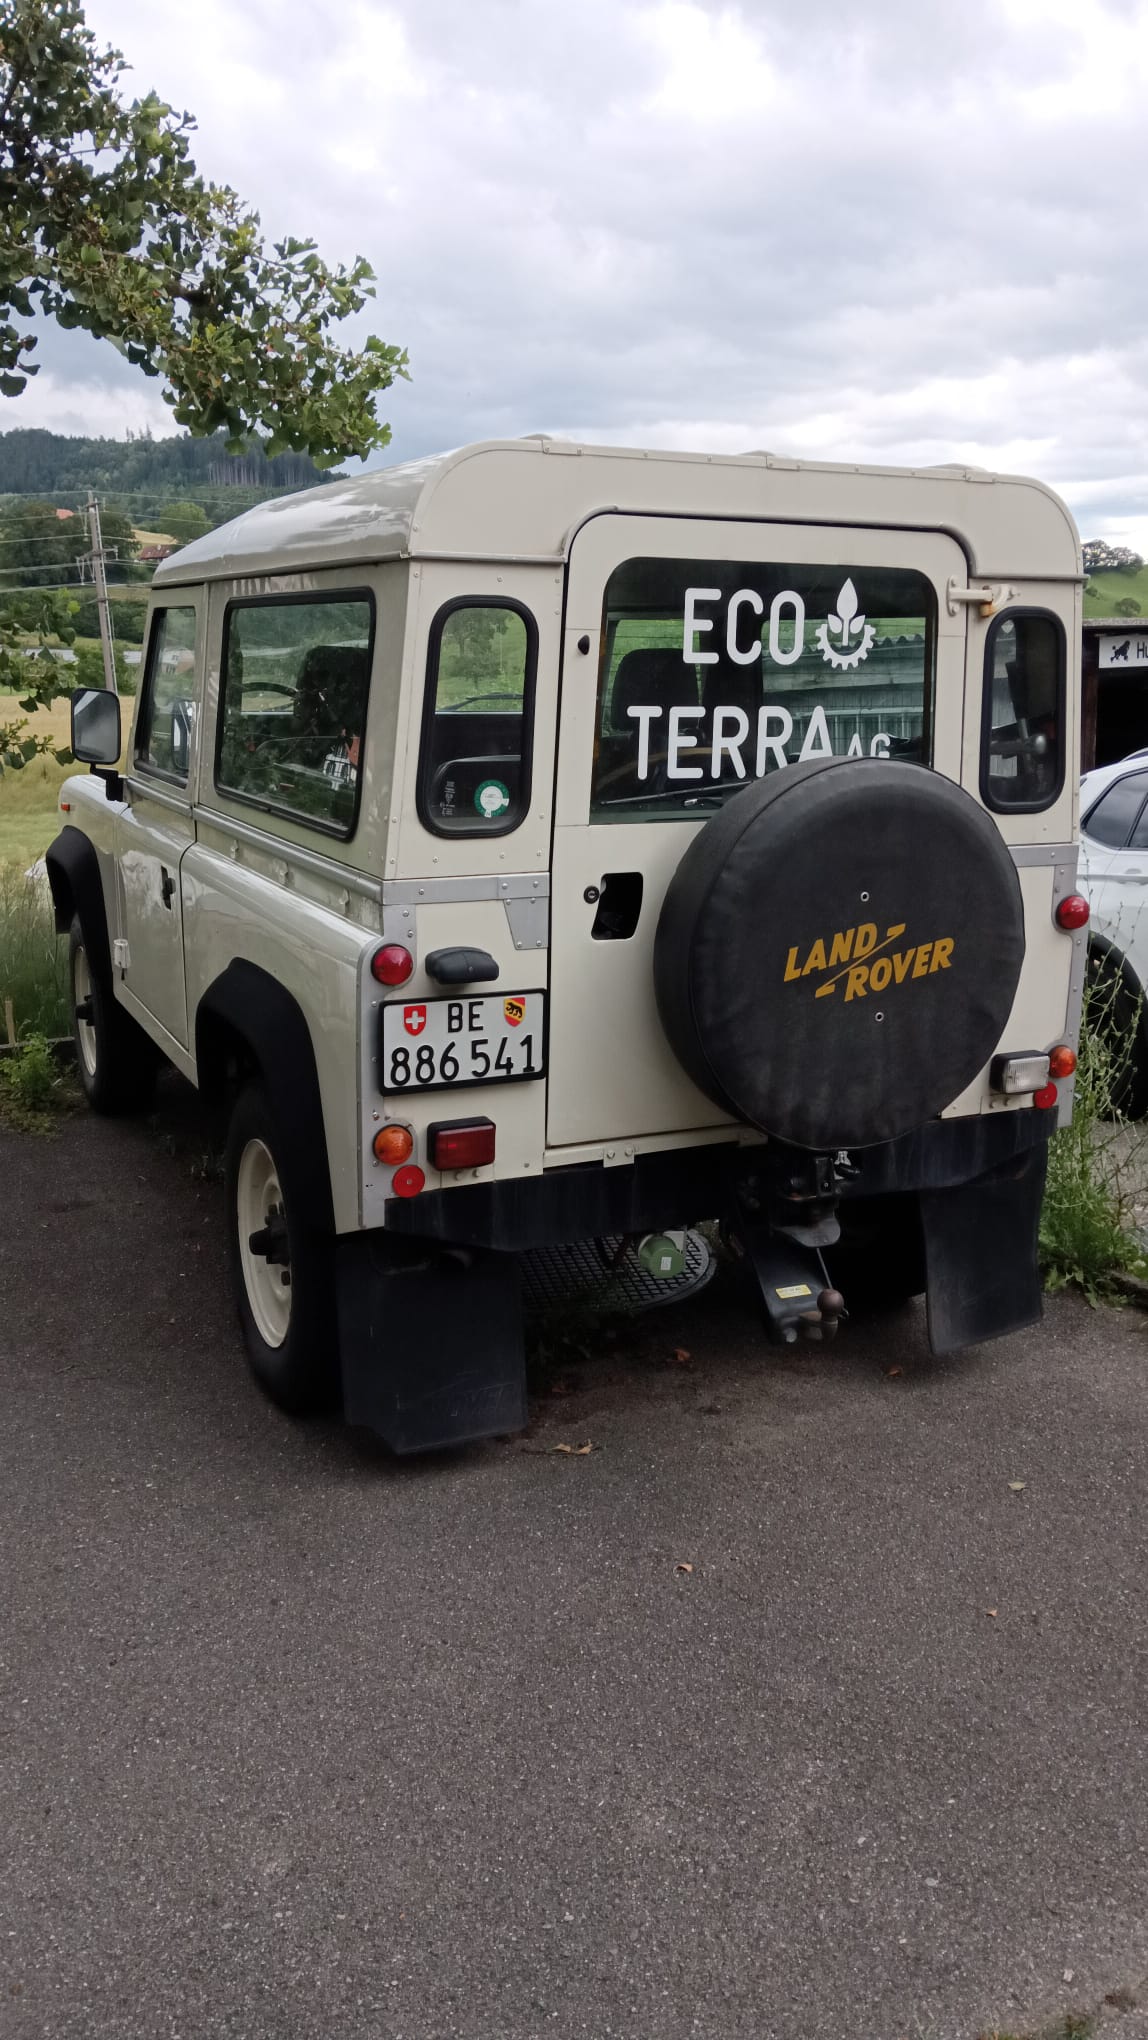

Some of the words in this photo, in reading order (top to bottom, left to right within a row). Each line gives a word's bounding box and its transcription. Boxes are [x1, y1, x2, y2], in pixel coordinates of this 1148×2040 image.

[682, 587, 806, 666] ECO
[626, 705, 834, 780] TERRA
[847, 732, 891, 758] AG
[783, 922, 878, 982] LAND
[843, 937, 955, 1003] ROVER
[447, 1000, 484, 1034] BE
